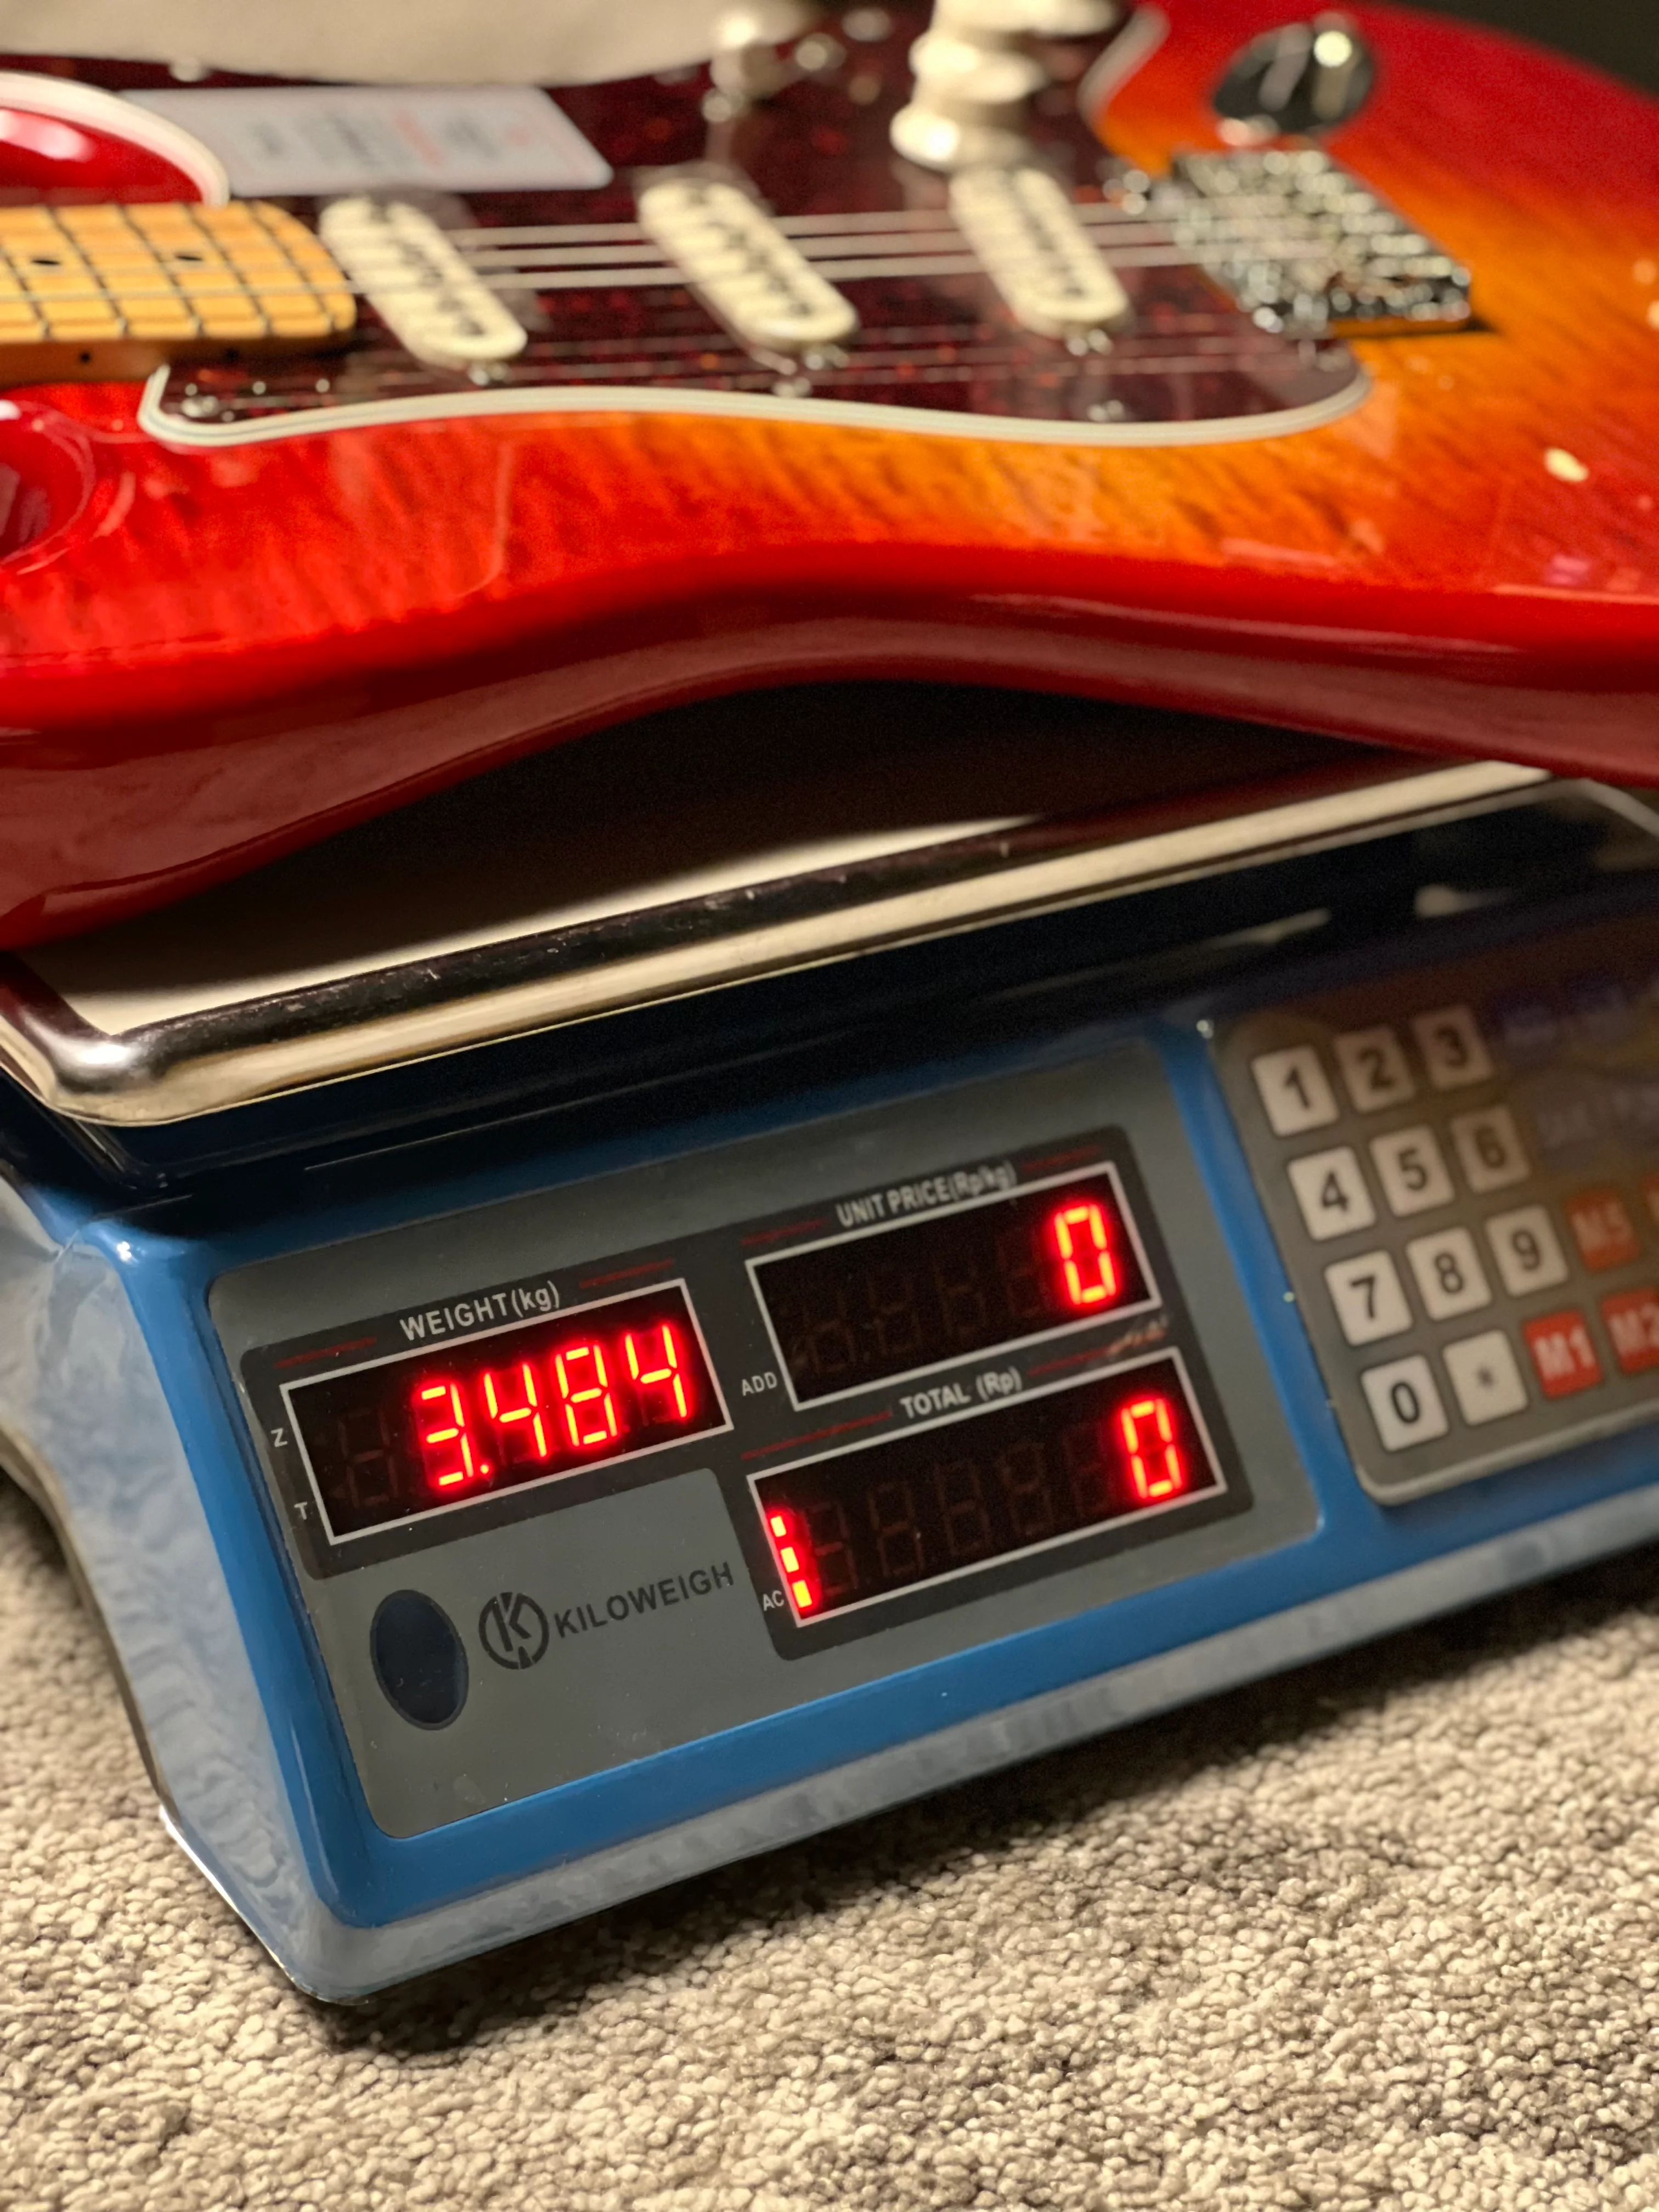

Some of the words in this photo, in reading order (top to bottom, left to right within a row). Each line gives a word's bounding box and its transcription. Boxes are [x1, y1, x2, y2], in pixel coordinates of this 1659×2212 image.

[1284, 1068, 1312, 1109] 1
[1361, 1047, 1393, 1086] 2
[1434, 1028, 1468, 1067] 3
[1321, 1172, 1347, 1211] 4
[1398, 1148, 1426, 1190] 5
[1474, 1126, 1506, 1169] 6
[836, 1192, 885, 1227] UNIT
[1053, 1205, 1117, 1305] 0
[1350, 1276, 1379, 1321] 7
[1436, 1252, 1464, 1295] 8
[1511, 1229, 1541, 1271] 9
[400, 1280, 560, 1341] WEIGHT(kg)
[418, 1323, 690, 1487] 3.484
[741, 1372, 777, 1396] ADD
[900, 1383, 971, 1419] TOTAL
[976, 1366, 1023, 1401] (Rp)
[1392, 1380, 1420, 1423] 0
[1534, 1325, 1595, 1381] M1
[272, 1429, 288, 1447] Z
[1121, 1398, 1183, 1499] 0
[295, 1502, 308, 1520] T
[554, 1562, 735, 1639] KILOWEIGH
[763, 1590, 785, 1611] AC
